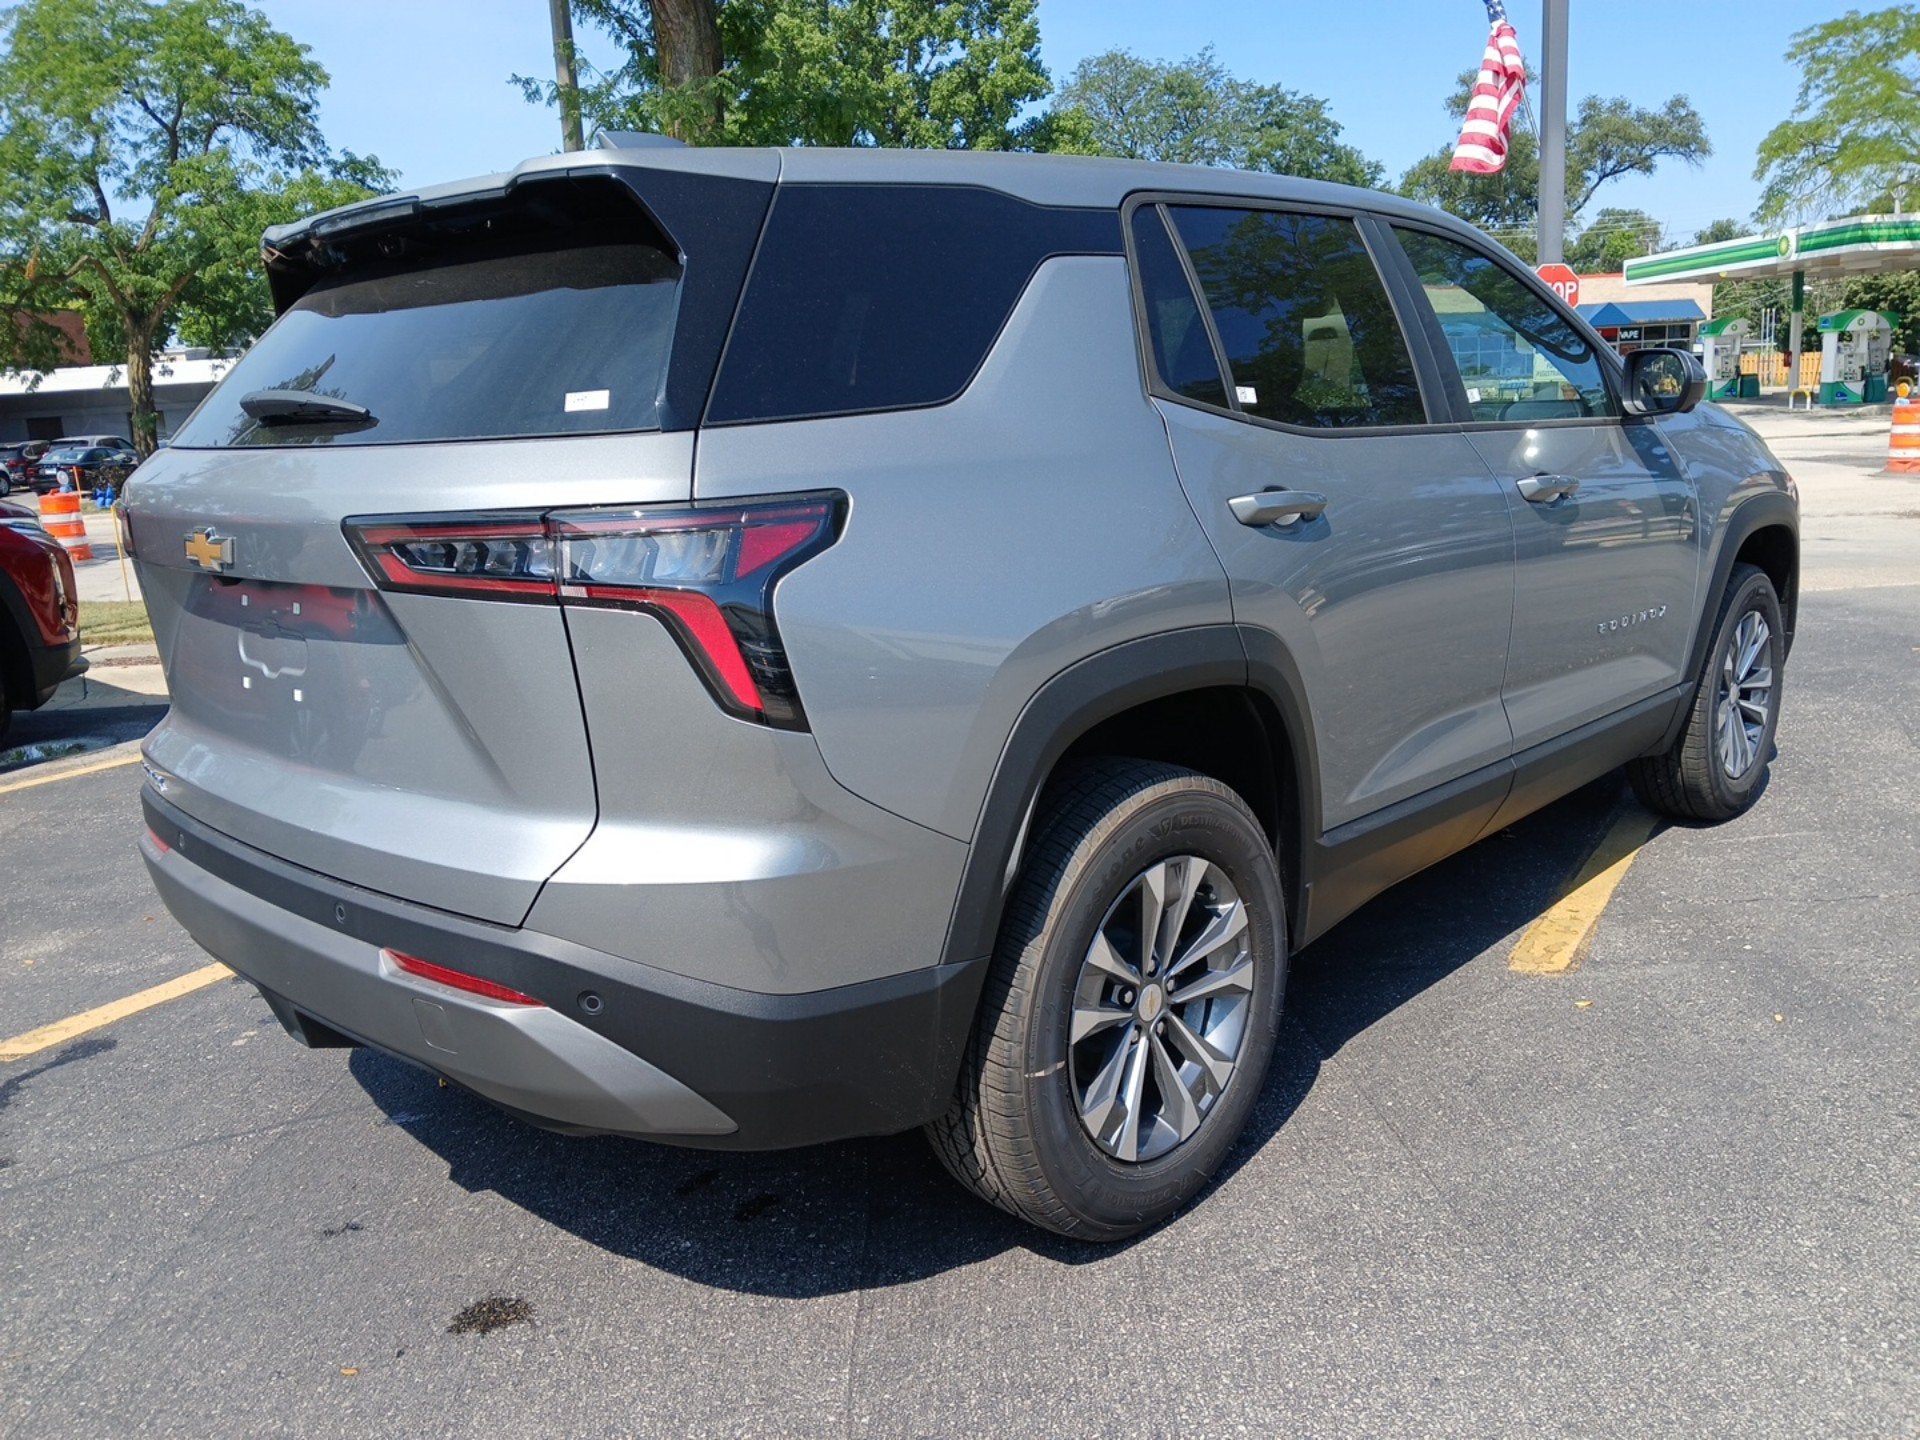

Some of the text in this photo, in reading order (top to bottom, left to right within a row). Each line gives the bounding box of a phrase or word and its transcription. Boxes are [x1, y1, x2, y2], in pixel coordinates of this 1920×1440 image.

[1545, 281, 1577, 303] OP
[1619, 330, 1639, 339] VAPE
[1598, 605, 1666, 633] EQUINOX
